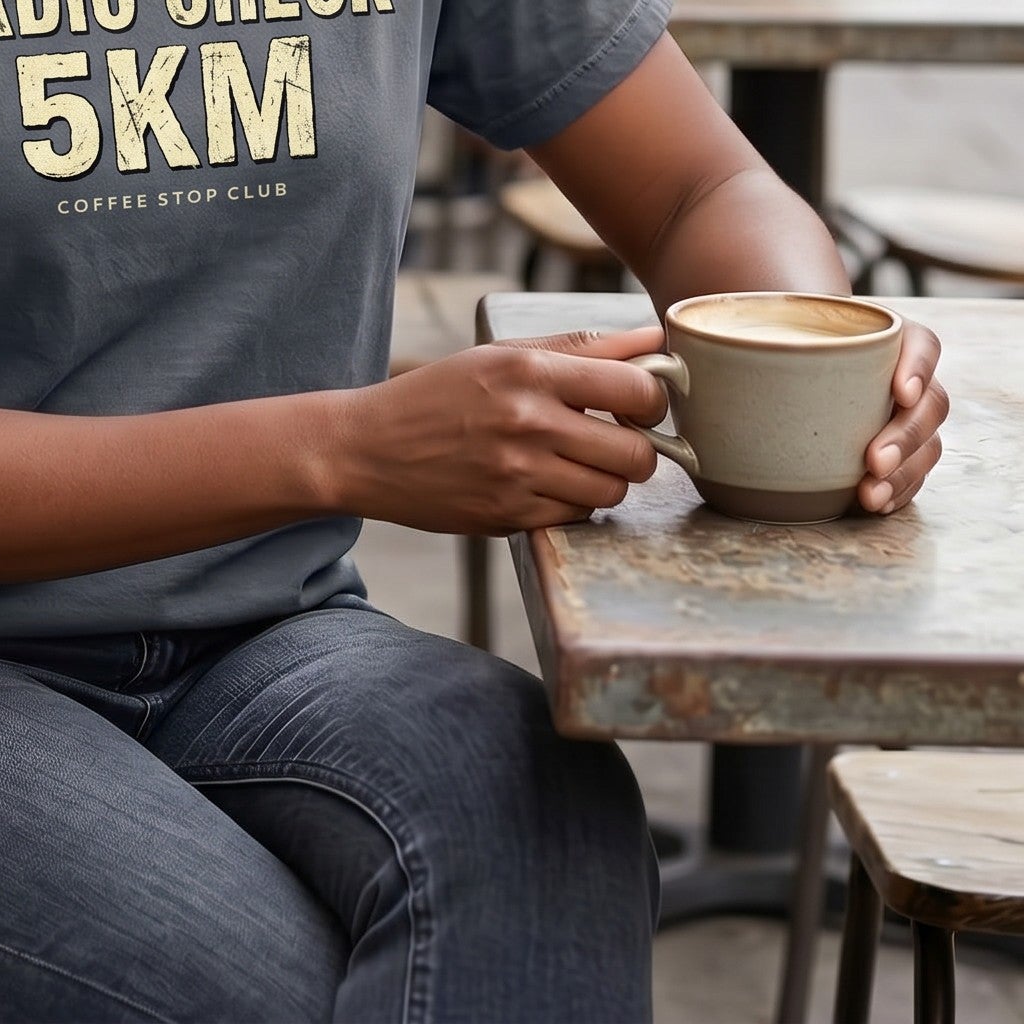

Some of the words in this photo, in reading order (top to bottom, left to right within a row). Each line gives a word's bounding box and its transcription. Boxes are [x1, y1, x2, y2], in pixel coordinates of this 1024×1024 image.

[16, 35, 318, 181] 5KM
[57, 194, 148, 215] COFFEE
[158, 188, 218, 206] STOP
[227, 182, 287, 201] CLUB
